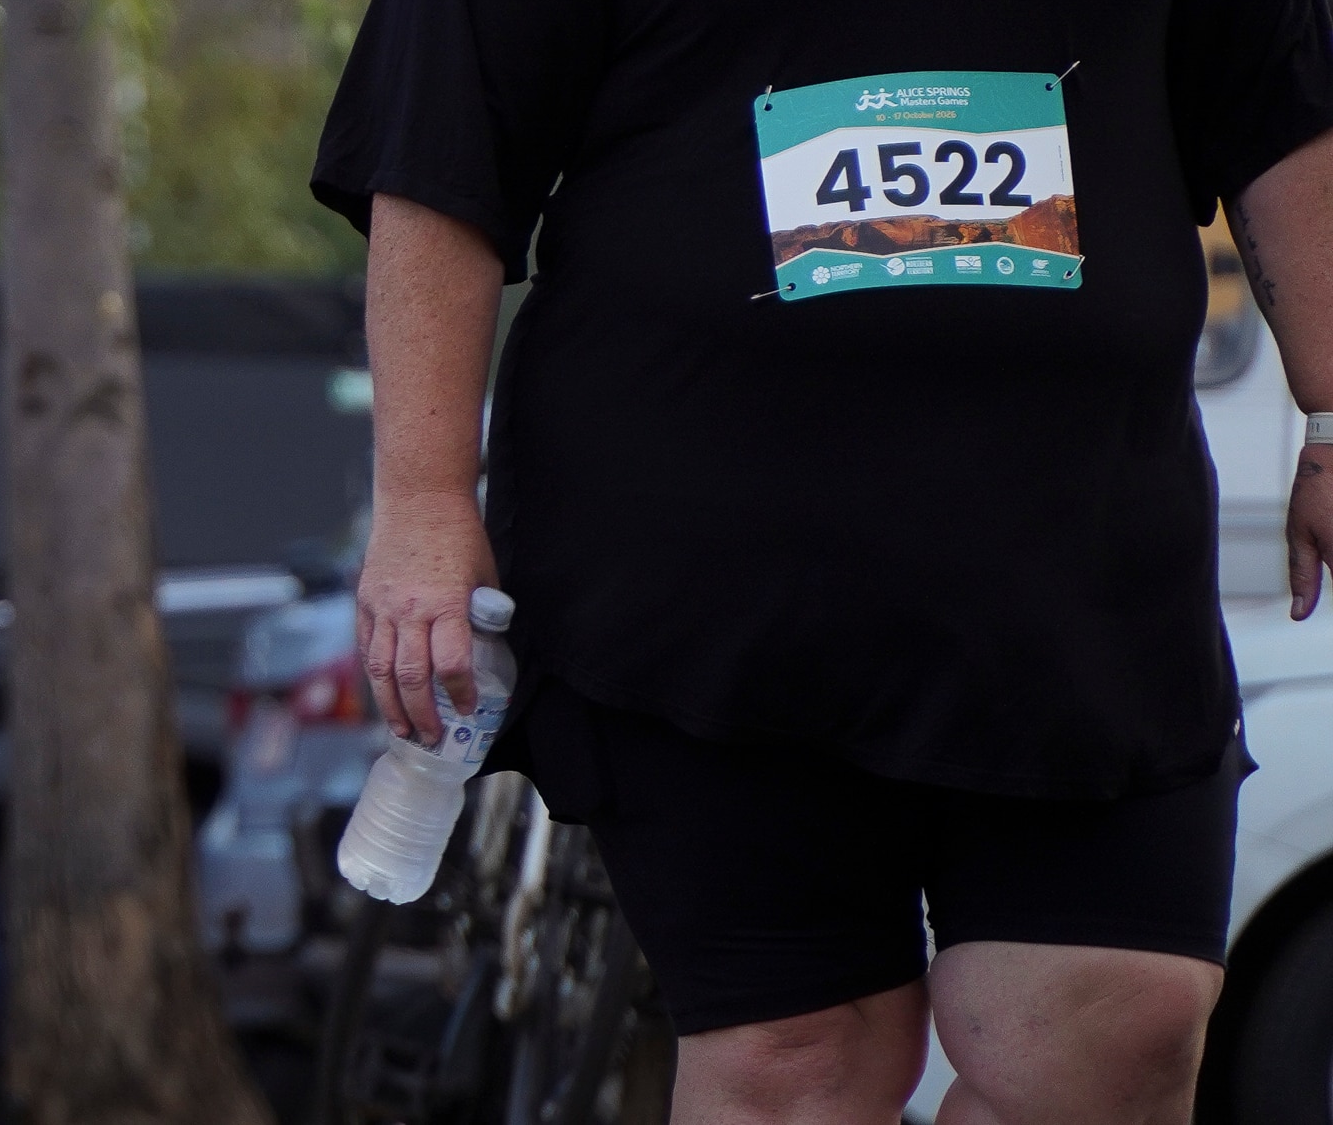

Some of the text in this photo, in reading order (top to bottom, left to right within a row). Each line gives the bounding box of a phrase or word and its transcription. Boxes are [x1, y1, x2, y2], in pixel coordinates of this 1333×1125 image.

[896, 87, 971, 98] ALICE SPRINGS
[900, 96, 969, 106] Masters Games
[816, 139, 1033, 213] 4522
